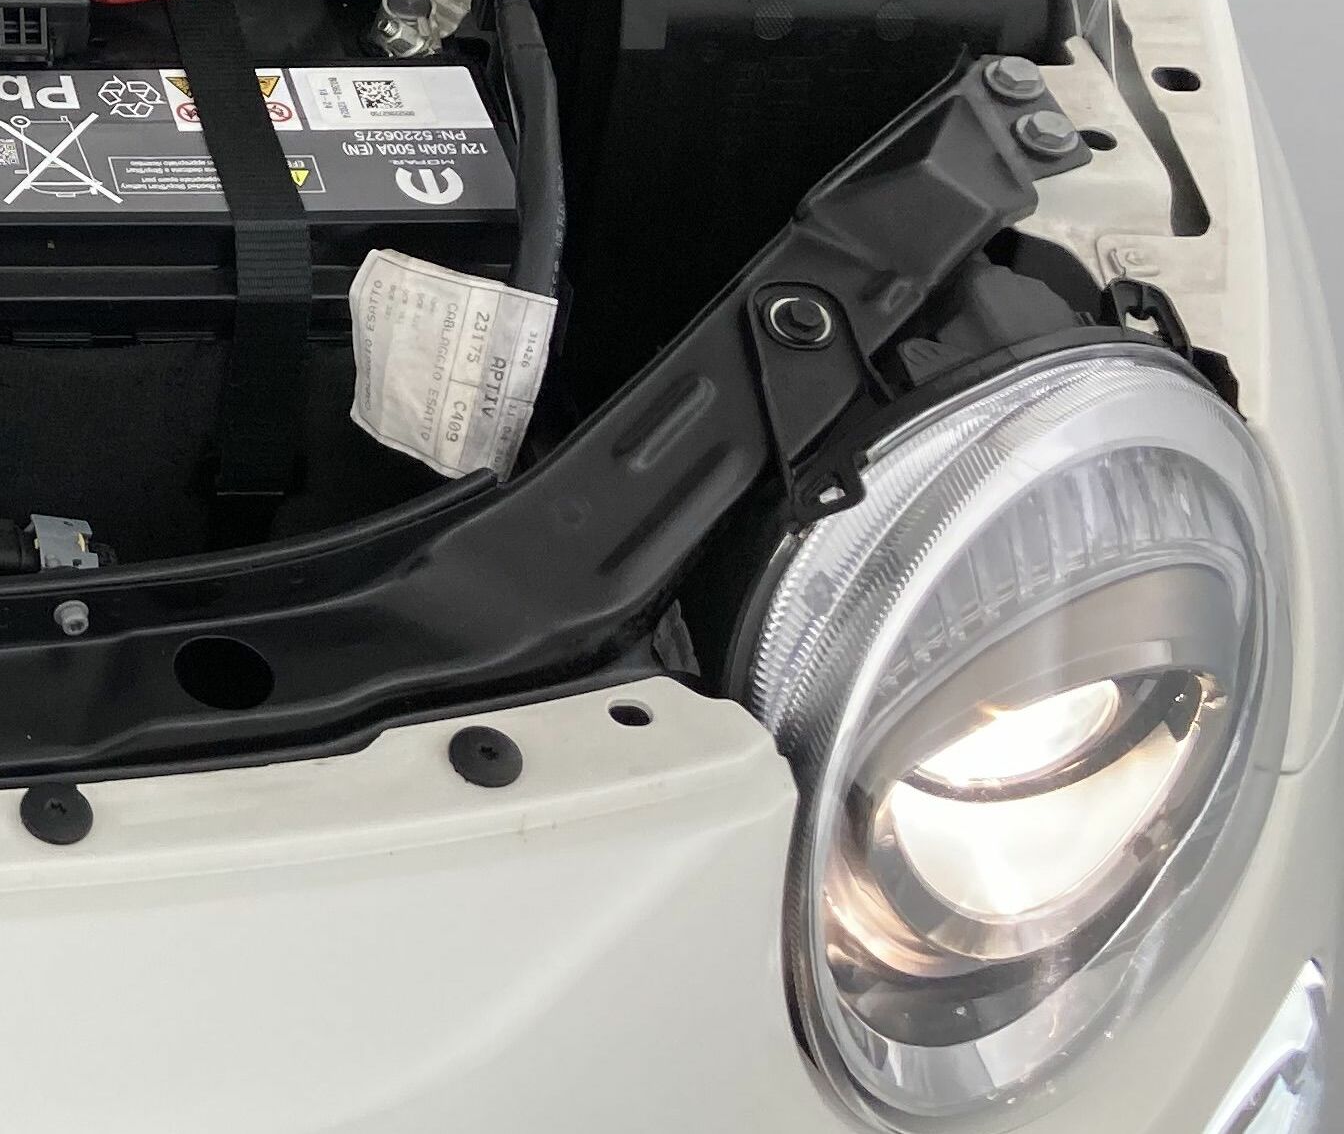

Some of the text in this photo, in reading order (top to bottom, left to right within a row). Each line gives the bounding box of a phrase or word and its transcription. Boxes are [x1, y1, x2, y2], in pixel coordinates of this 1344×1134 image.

[342, 142, 488, 157] 12V 50Ah 500A (EN)
[354, 130, 468, 142] PN: 52206275
[368, 279, 383, 332] ESATTO
[431, 302, 460, 381] CABLAGGIO
[465, 311, 491, 364] 23175
[520, 331, 538, 368] 31426
[480, 356, 507, 418] APTIV
[420, 388, 441, 441] ESATTO
[445, 400, 468, 443] C409
